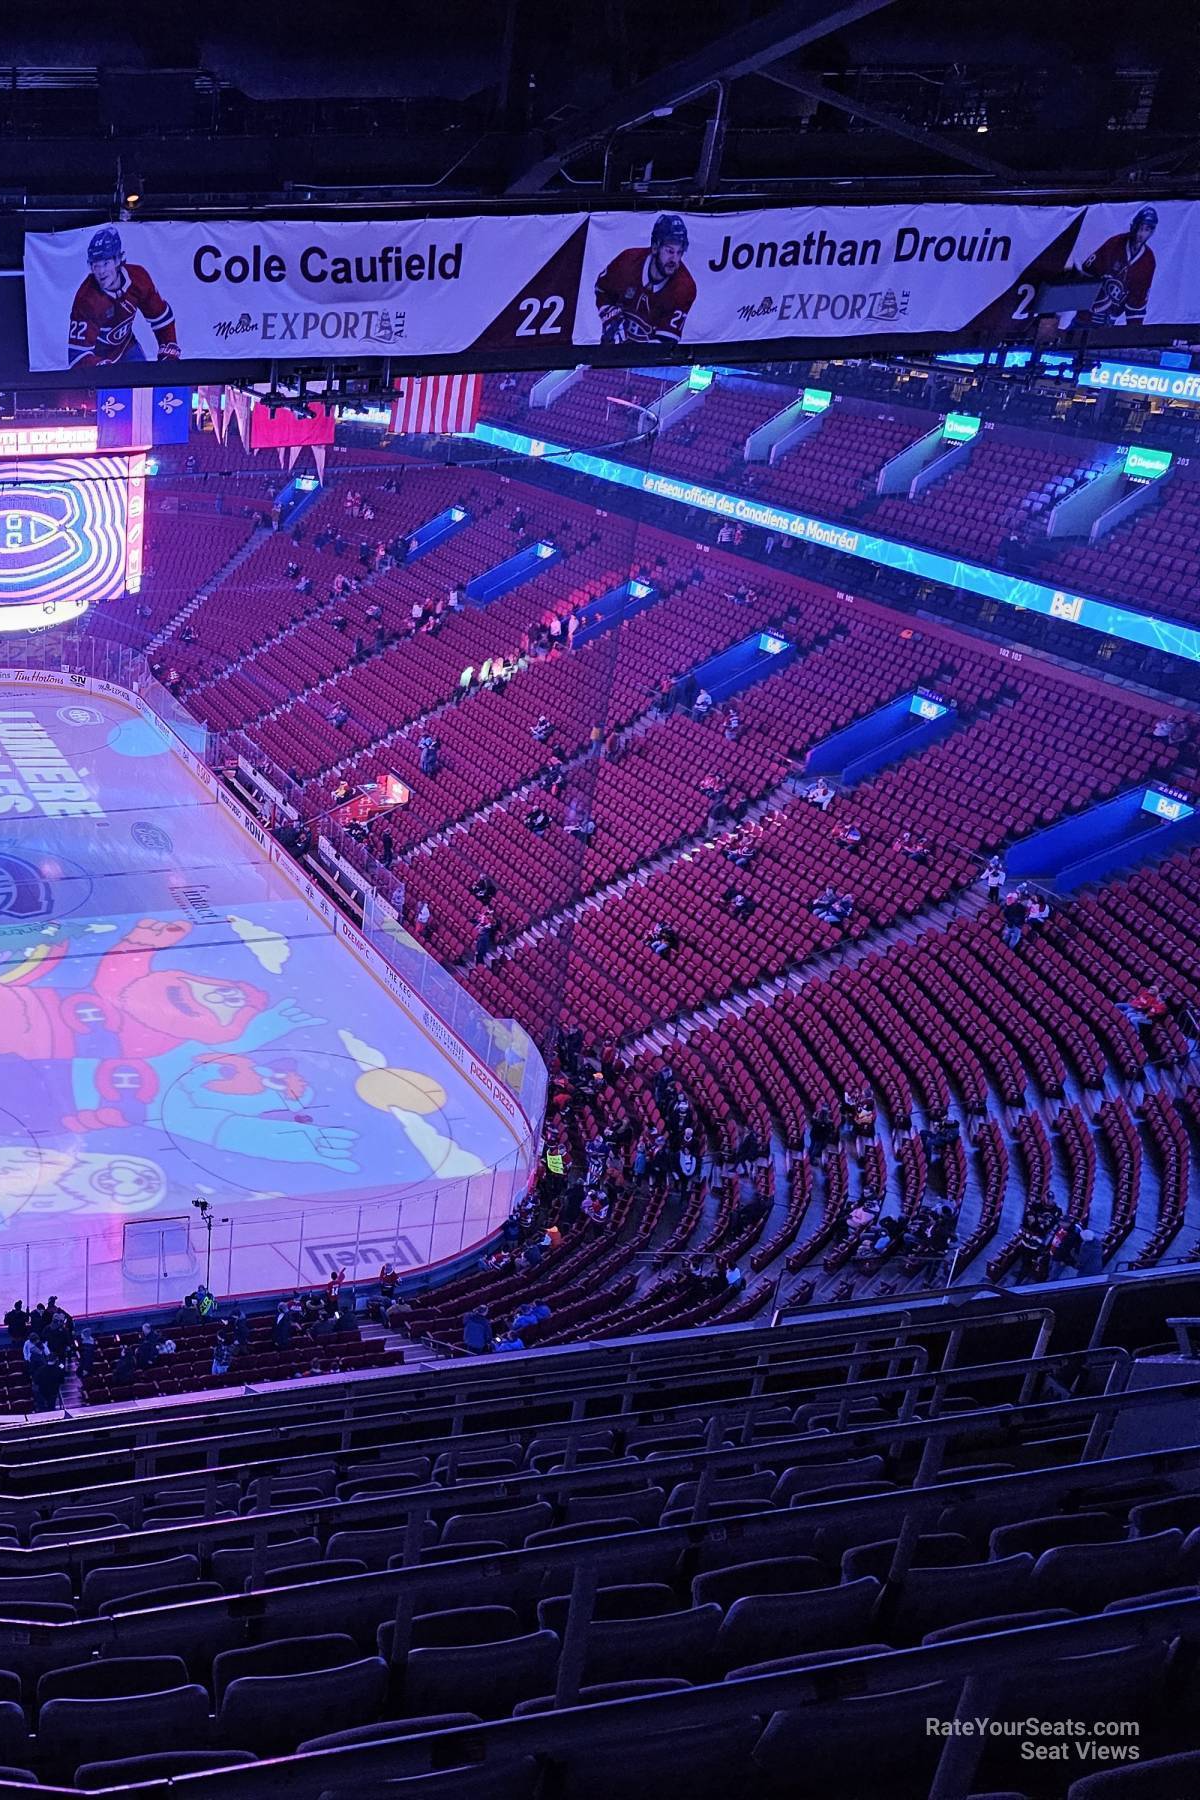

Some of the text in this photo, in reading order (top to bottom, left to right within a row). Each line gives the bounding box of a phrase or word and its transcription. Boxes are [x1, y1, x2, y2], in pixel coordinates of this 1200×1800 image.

[193, 242, 464, 285] Cole Caufield
[708, 226, 1012, 273] Jonathan Drouin
[516, 296, 565, 338] 22
[736, 290, 910, 322] Molson EXPORT ALE
[70, 320, 88, 340] 22
[212, 310, 406, 342] Molson EXPORT ALE
[1112, 368, 1168, 392] réseau
[654, 478, 684, 500] réseau
[684, 486, 716, 508] officiel
[716, 495, 734, 514] des
[734, 500, 790, 530] Canadiens
[790, 516, 806, 534] de
[806, 521, 858, 552] Montréal
[1050, 590, 1084, 622] Bell
[470, 1061, 514, 1118] pizza pizza
